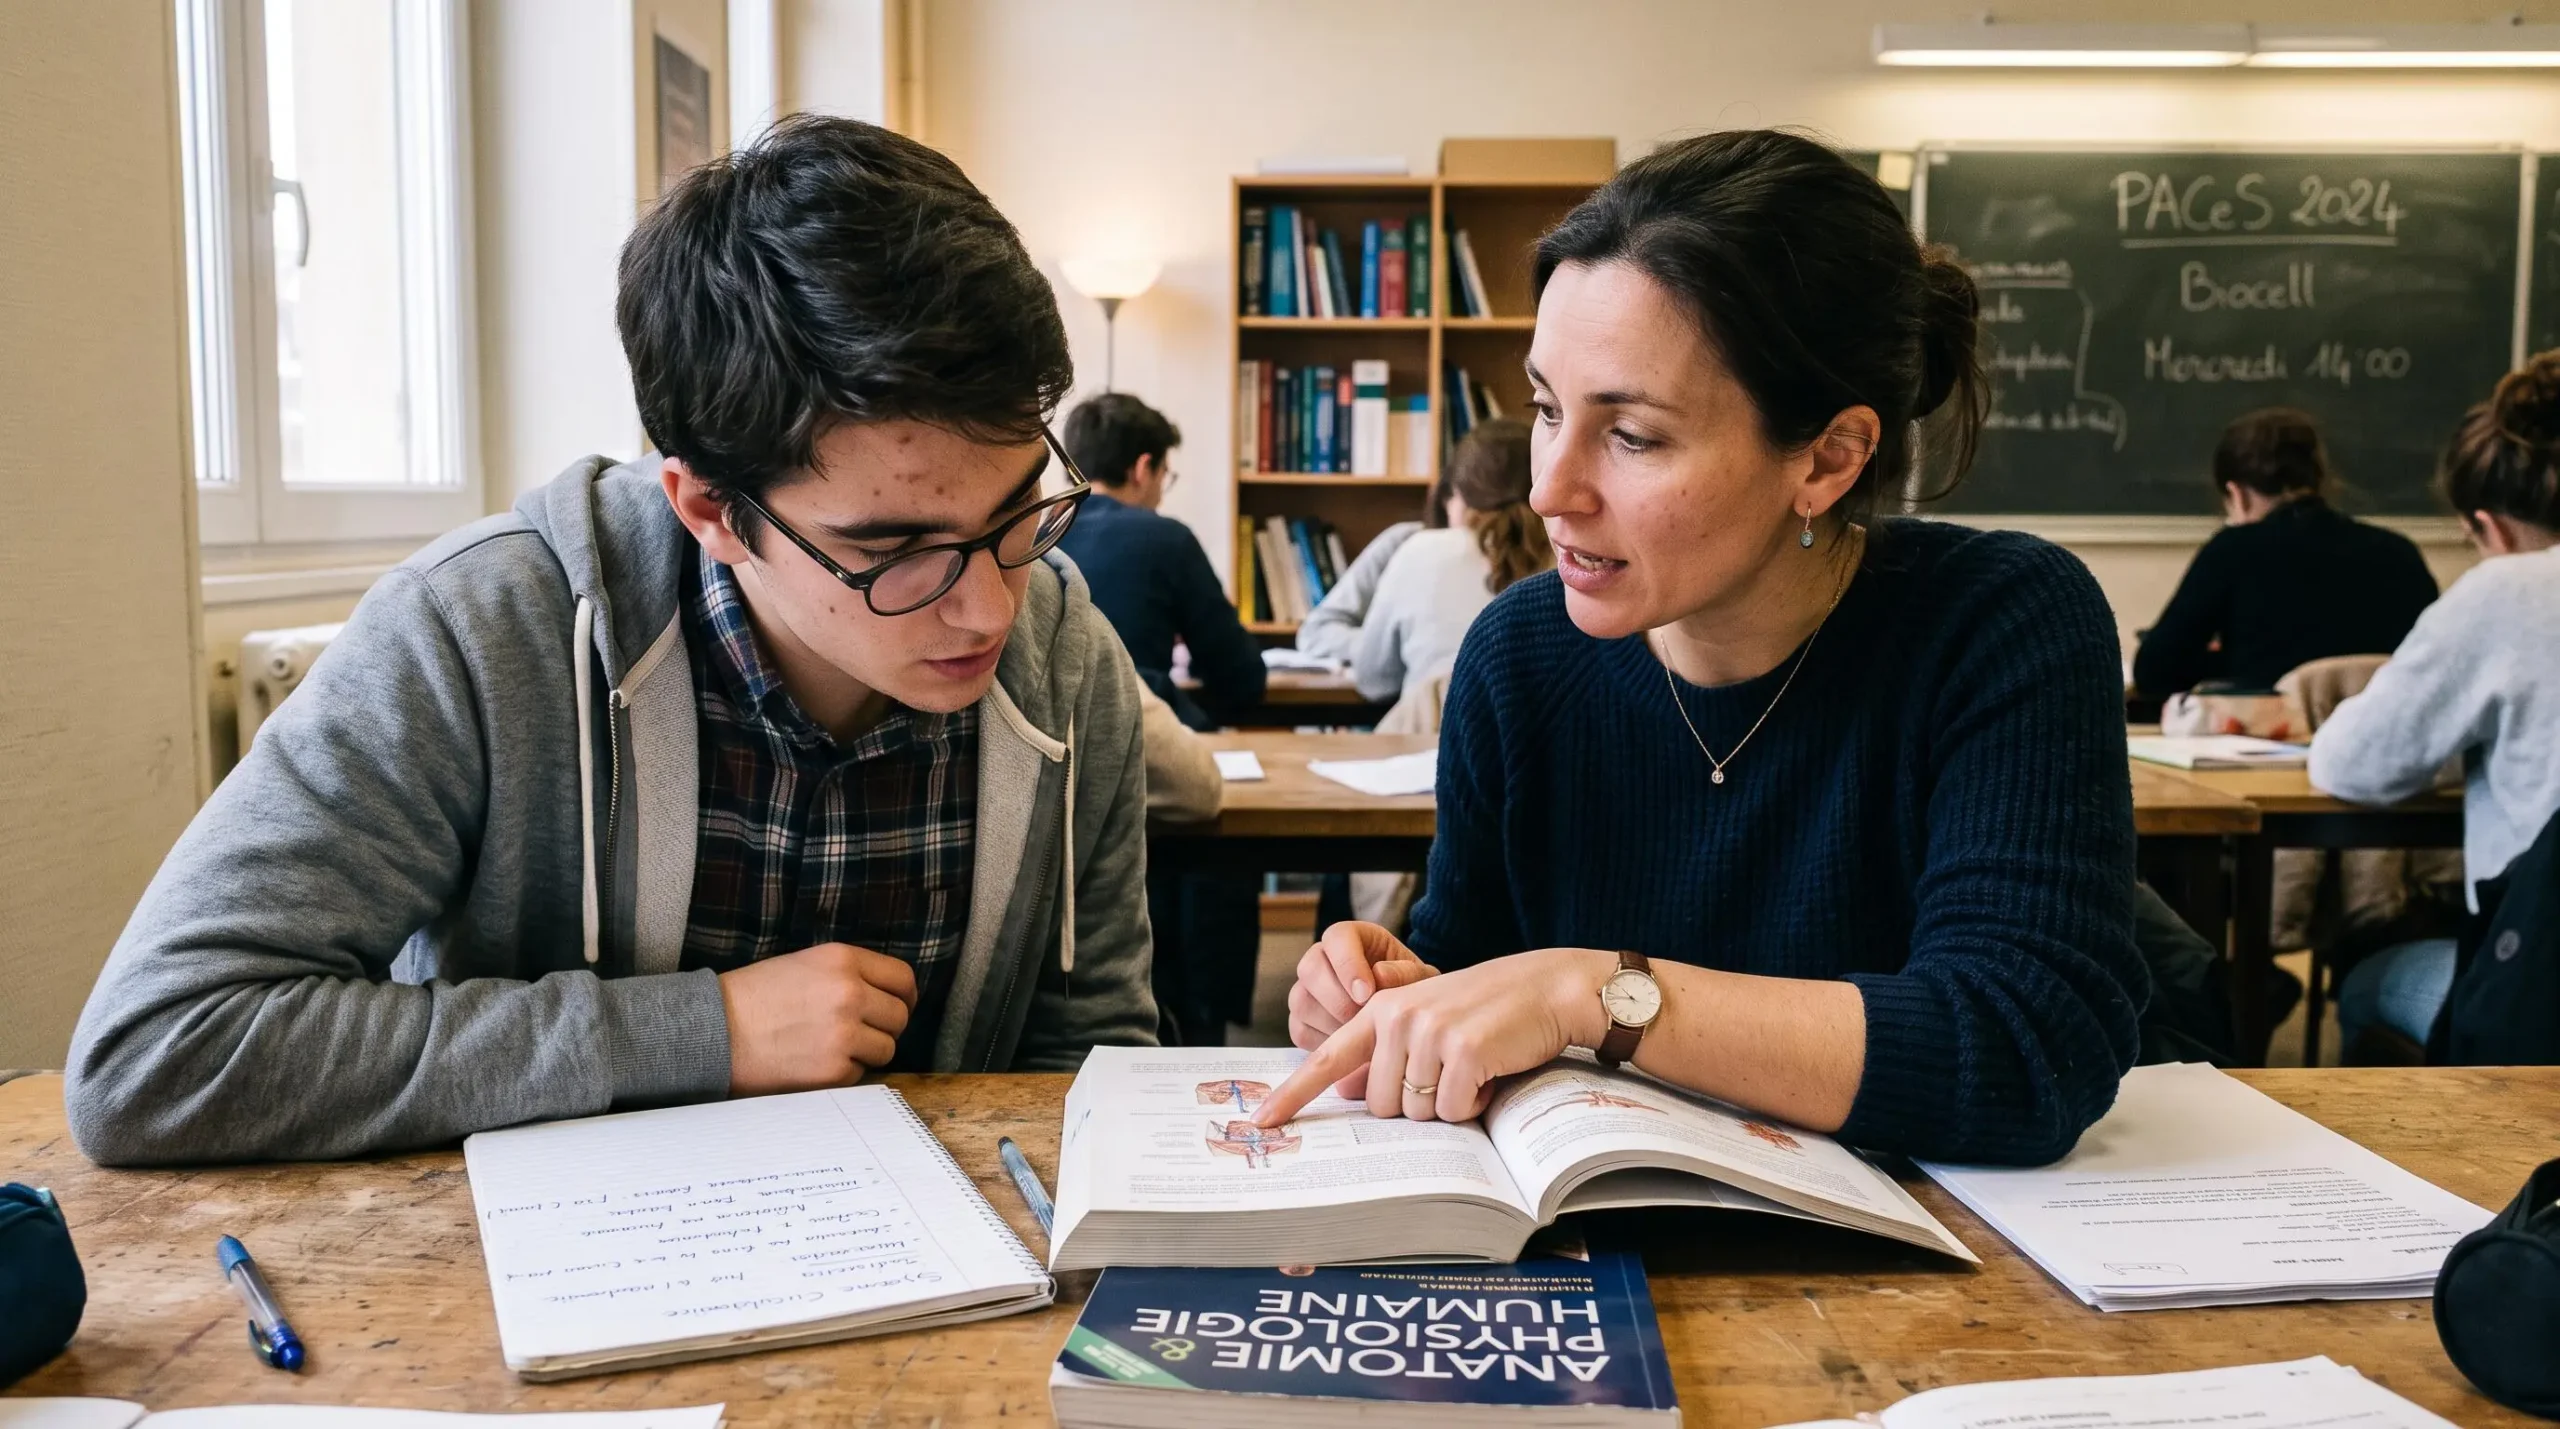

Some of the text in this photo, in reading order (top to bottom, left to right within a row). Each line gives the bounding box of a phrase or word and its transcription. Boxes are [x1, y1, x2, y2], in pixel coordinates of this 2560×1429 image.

[2110, 171, 2409, 235] PACeS 2024
[2180, 260, 2315, 312] Biocell
[1255, 1289, 1600, 1324] HUMAINE
[1130, 1308, 1605, 1353] PHYSIOLOGIE
[1149, 1336, 1196, 1361] &
[1212, 1341, 1610, 1382] ANATOMIE
